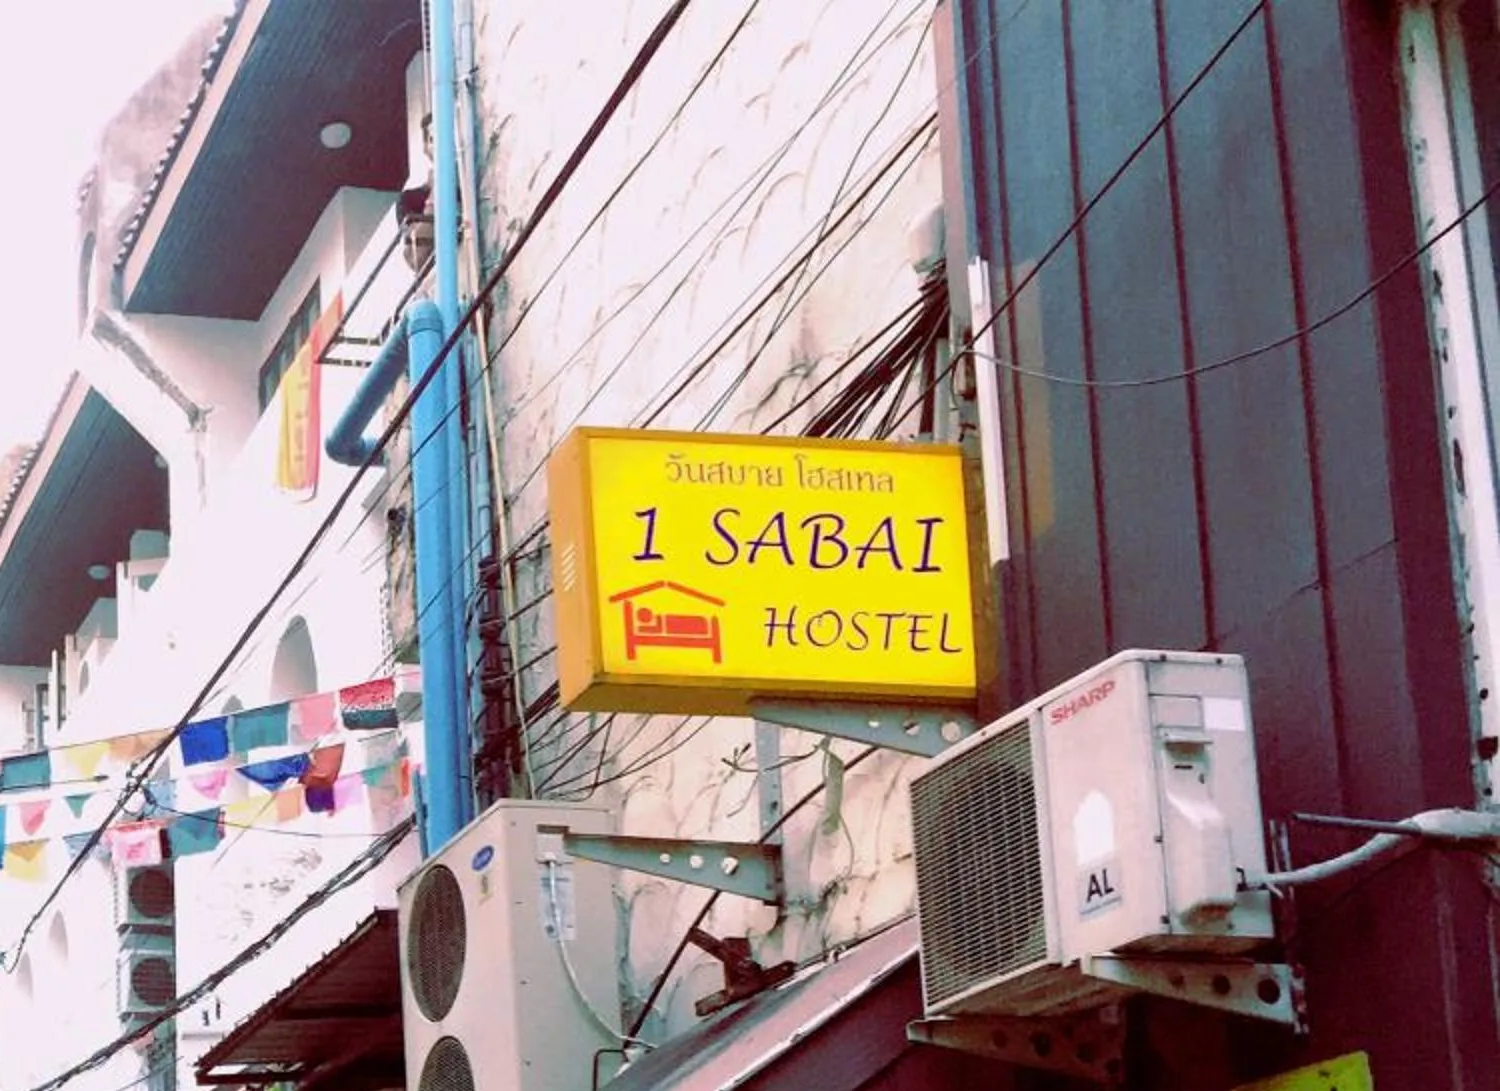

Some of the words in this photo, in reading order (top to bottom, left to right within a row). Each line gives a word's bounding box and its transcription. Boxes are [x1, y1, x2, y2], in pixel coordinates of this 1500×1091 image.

[665, 452, 783, 488] วันสบาย
[793, 453, 895, 493] โฮสเทล
[633, 507, 665, 562] 1
[705, 508, 945, 574] SABAI
[764, 605, 963, 653] HOSTEL
[1051, 680, 1116, 726] SHARP
[1086, 868, 1116, 904] AL
